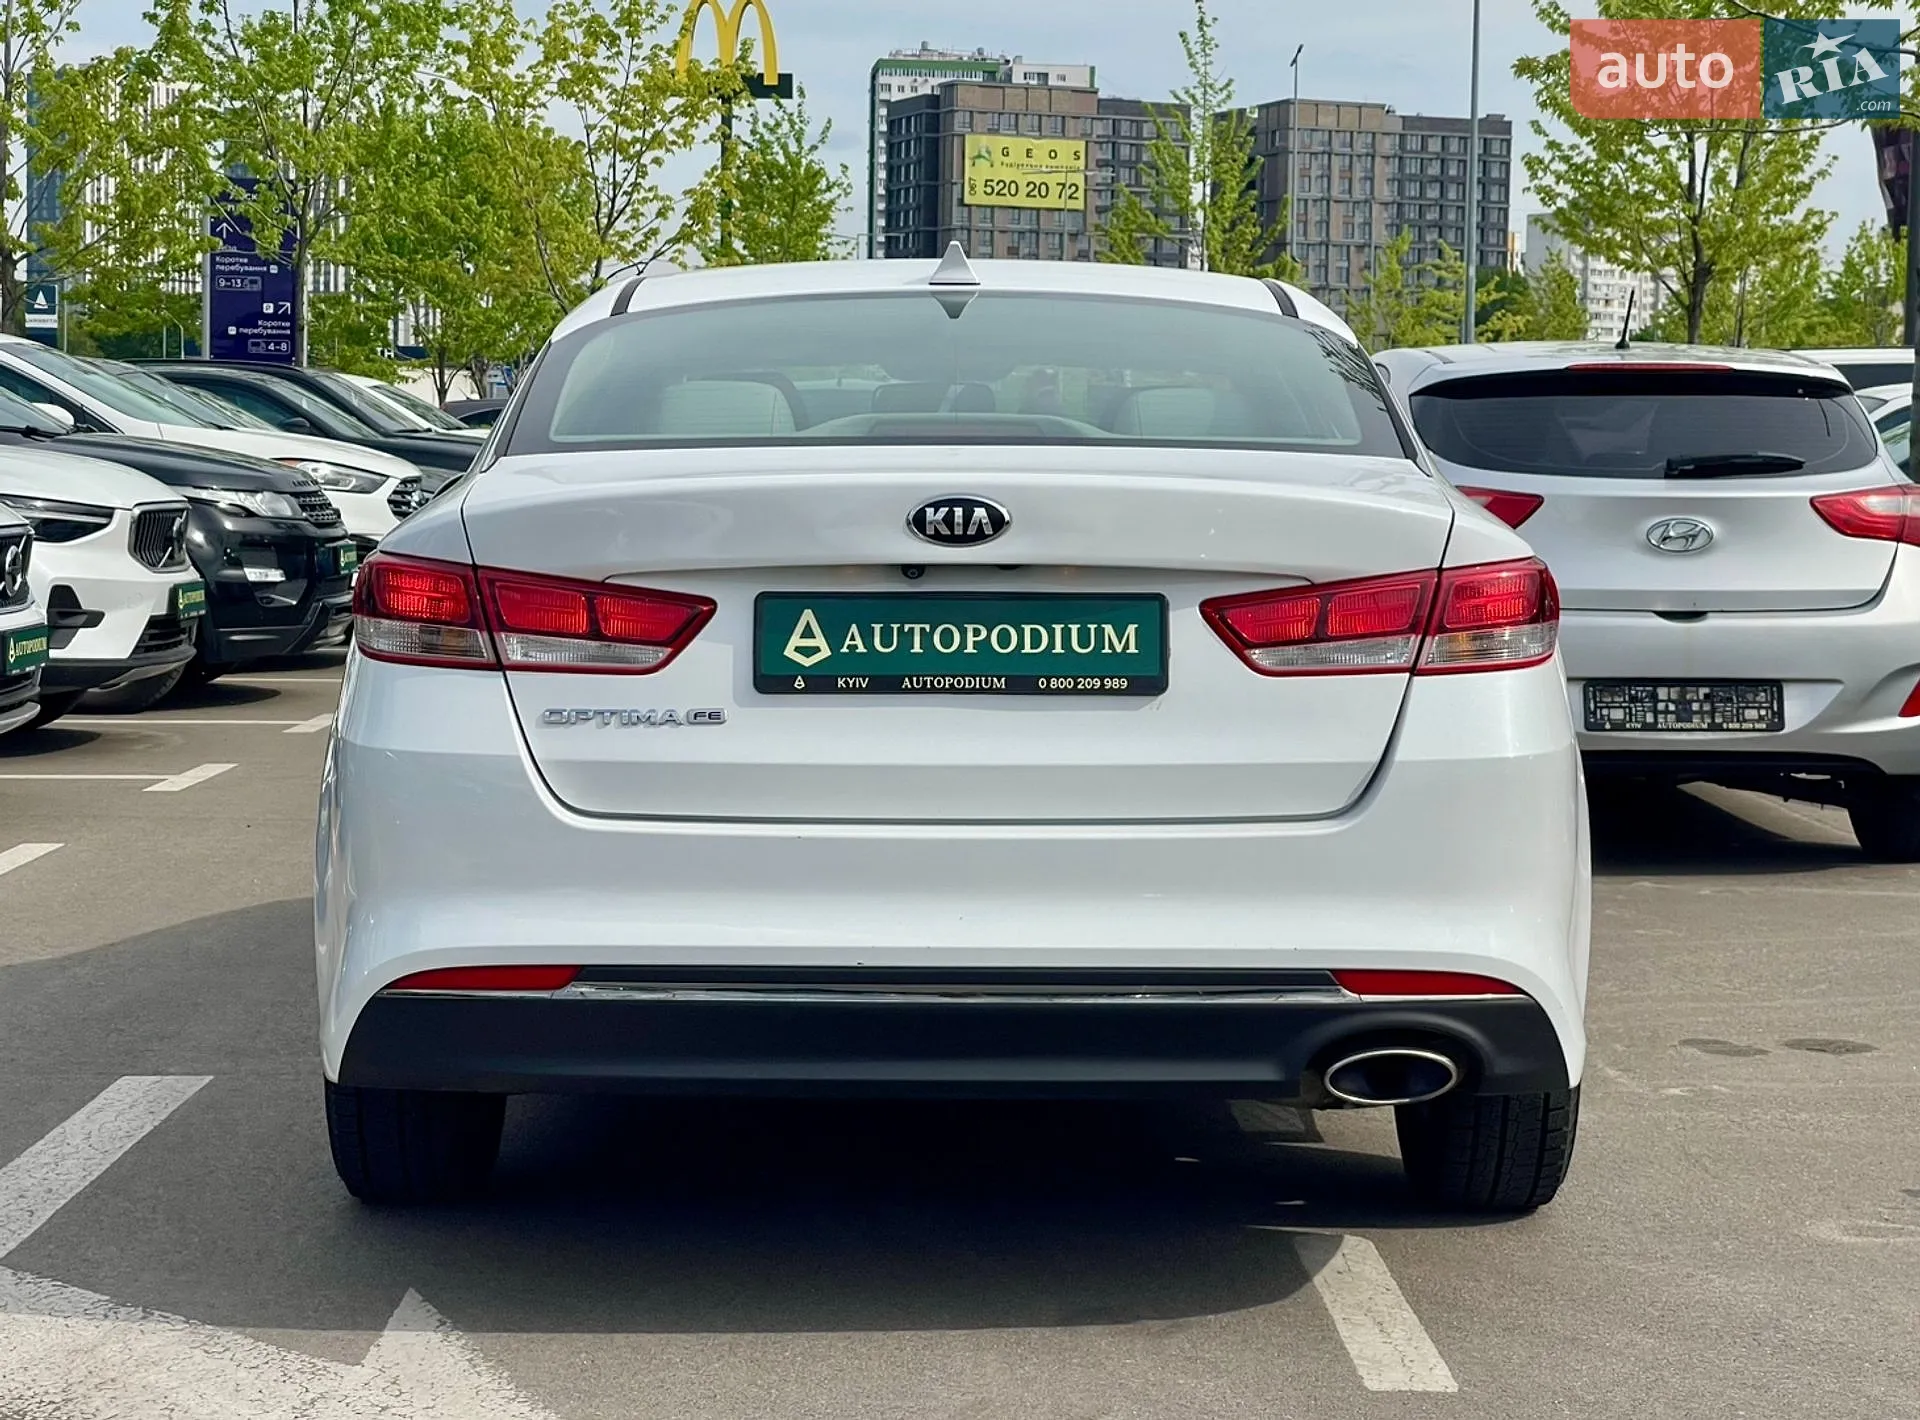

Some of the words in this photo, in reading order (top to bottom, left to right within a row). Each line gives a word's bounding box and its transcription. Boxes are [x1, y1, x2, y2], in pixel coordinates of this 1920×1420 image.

[1001, 147, 1081, 161] GEOS
[983, 179, 1019, 197] 520
[1025, 181, 1049, 199] 20
[1056, 183, 1079, 200] 72
[924, 507, 994, 535] KIA
[840, 623, 1139, 654] AUTOPODIUM
[837, 677, 869, 689] KYIV
[902, 677, 1006, 690] AUTOPODIUM
[1038, 678, 1047, 690] 0
[1049, 678, 1075, 690] 800
[1076, 678, 1101, 690] 209
[1103, 678, 1128, 690] 989
[544, 708, 684, 726] OPTIMA
[691, 710, 723, 722] FE
